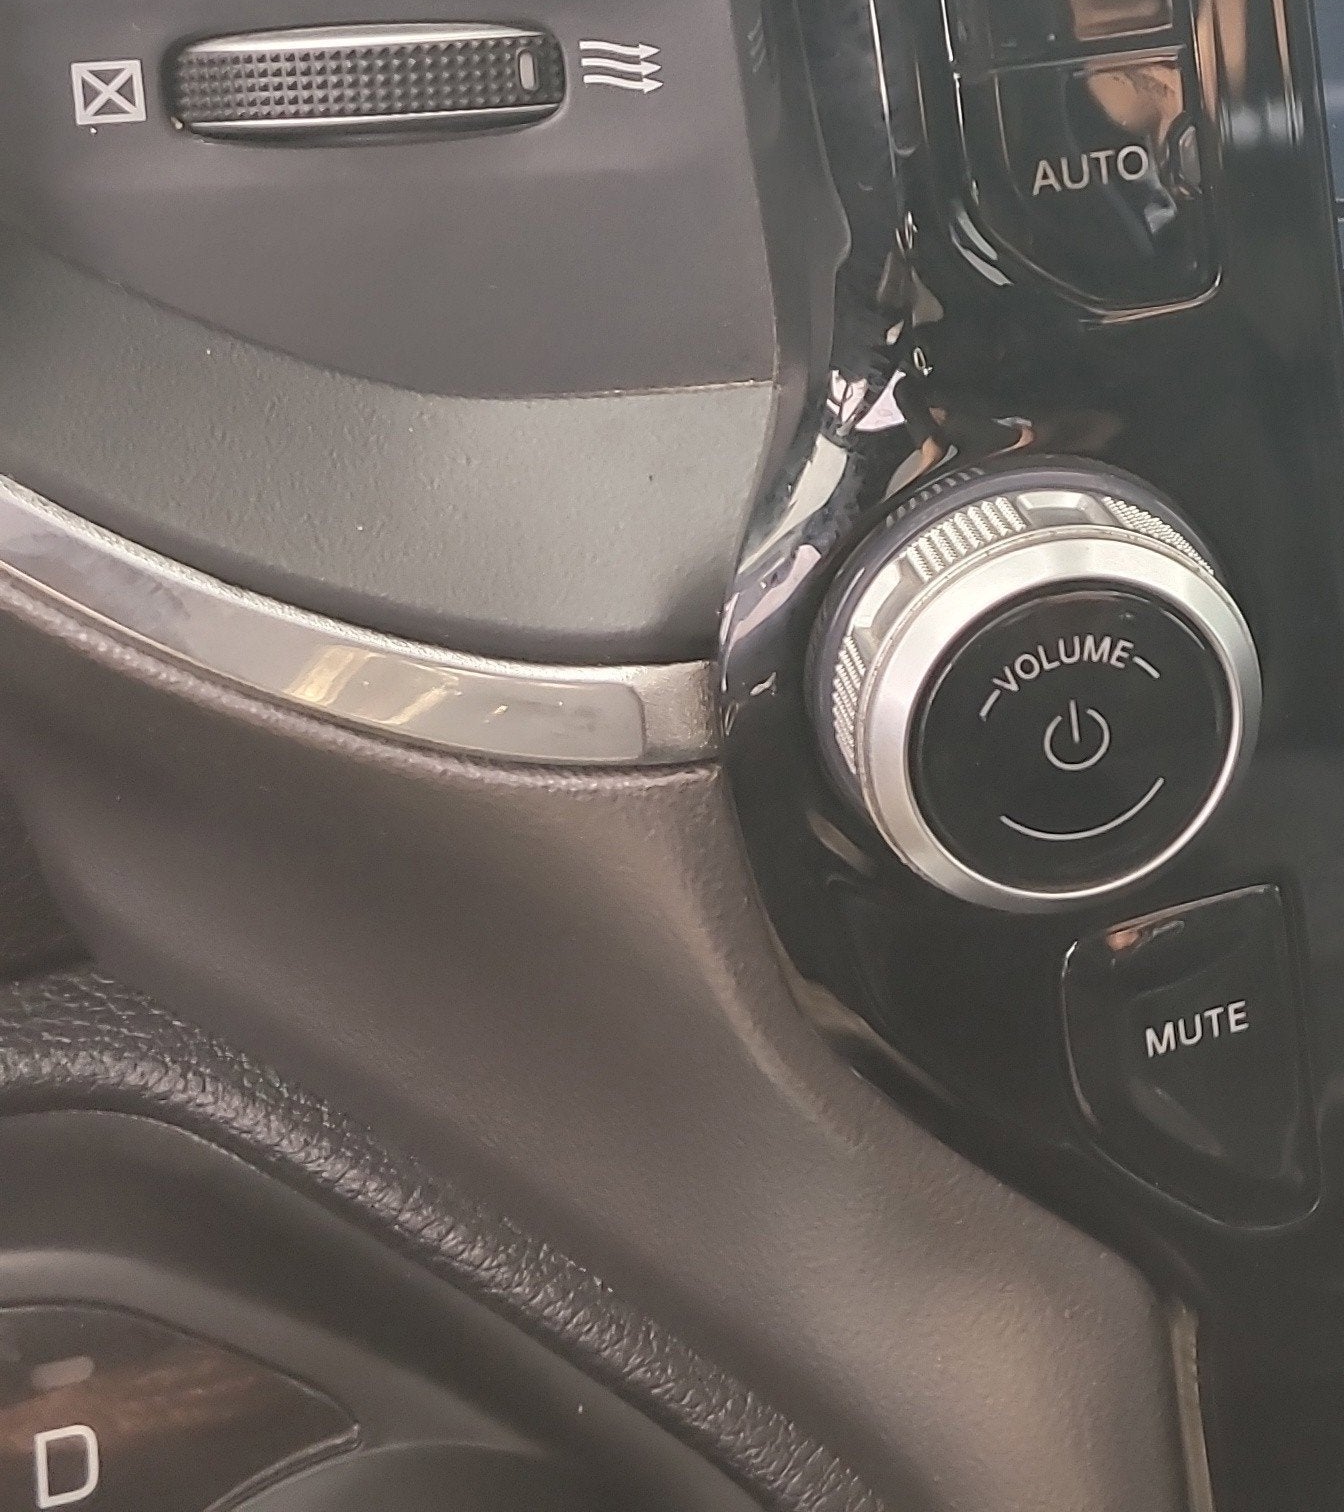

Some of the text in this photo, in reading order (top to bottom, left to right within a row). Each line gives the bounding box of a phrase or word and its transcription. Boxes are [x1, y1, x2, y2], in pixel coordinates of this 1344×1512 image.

[1031, 145, 1150, 195] AUTO
[992, 634, 1134, 695] VOLUME
[1144, 1000, 1250, 1058] MUTE
[34, 1424, 99, 1509] D
